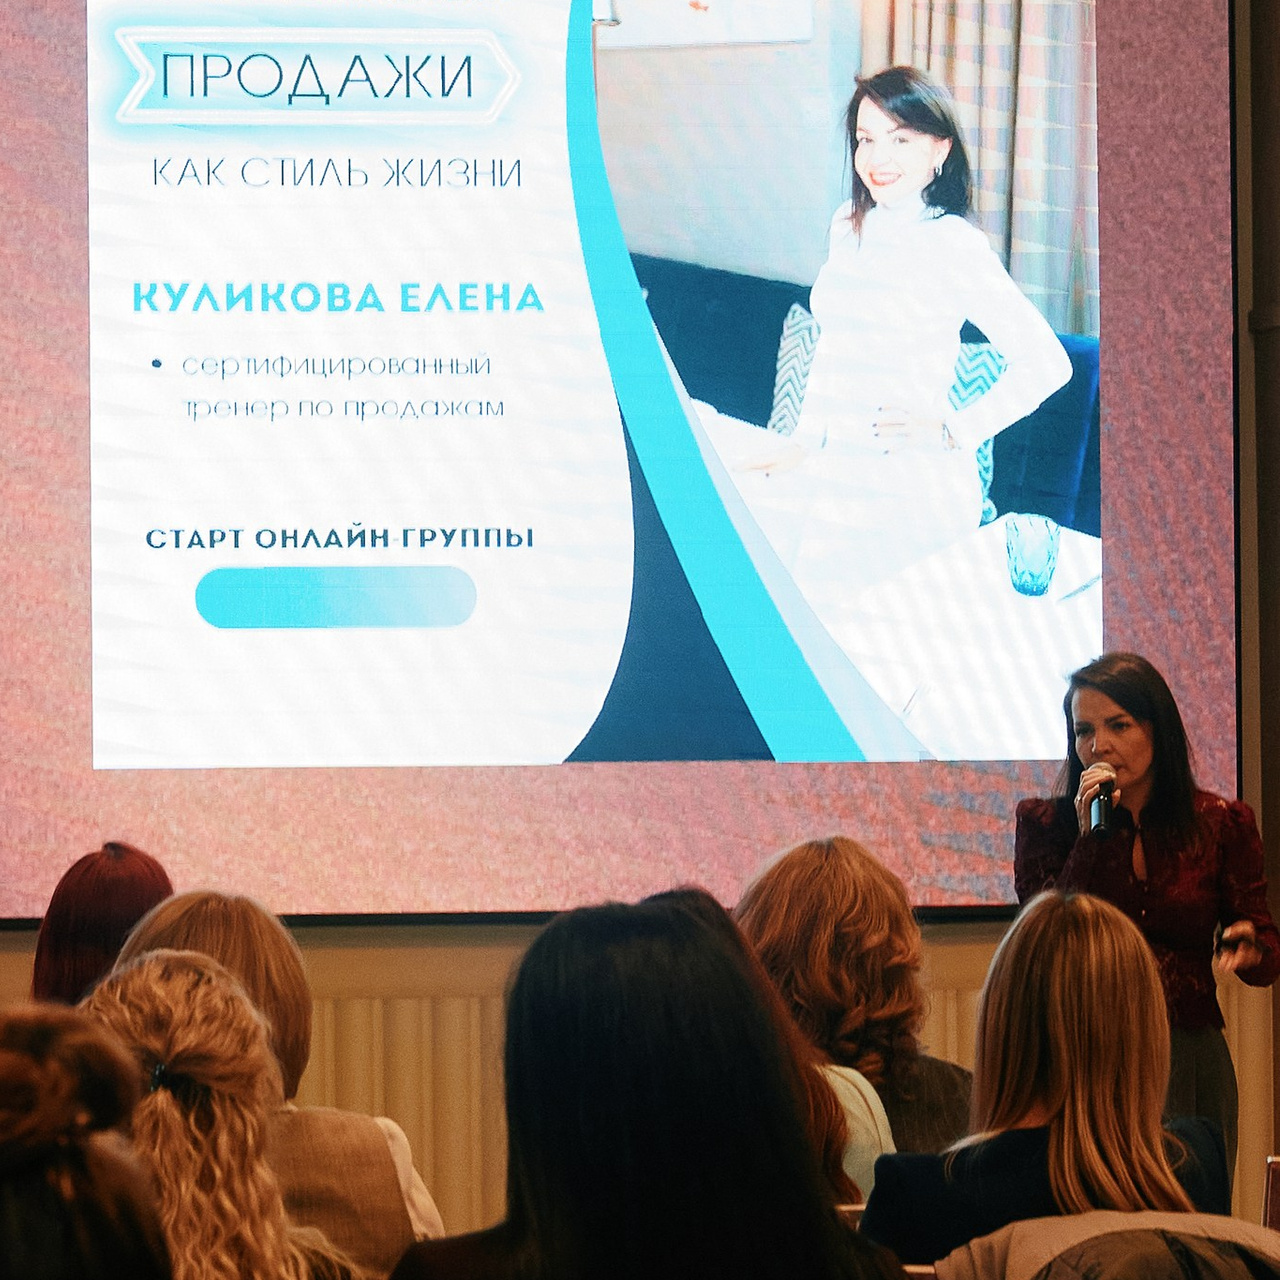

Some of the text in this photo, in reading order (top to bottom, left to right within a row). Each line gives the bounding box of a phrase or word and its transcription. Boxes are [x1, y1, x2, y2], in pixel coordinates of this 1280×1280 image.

[161, 52, 473, 106] ПРОДАЖИ
[152, 156, 523, 189] КАК СТИЛЬ ЖИЗНИ
[132, 280, 546, 314] КУЛИКОВА ЕЛЕНА
[181, 351, 492, 382] сертифицированный
[181, 398, 505, 424] тренер по продажам
[145, 527, 246, 551] СТАРТ
